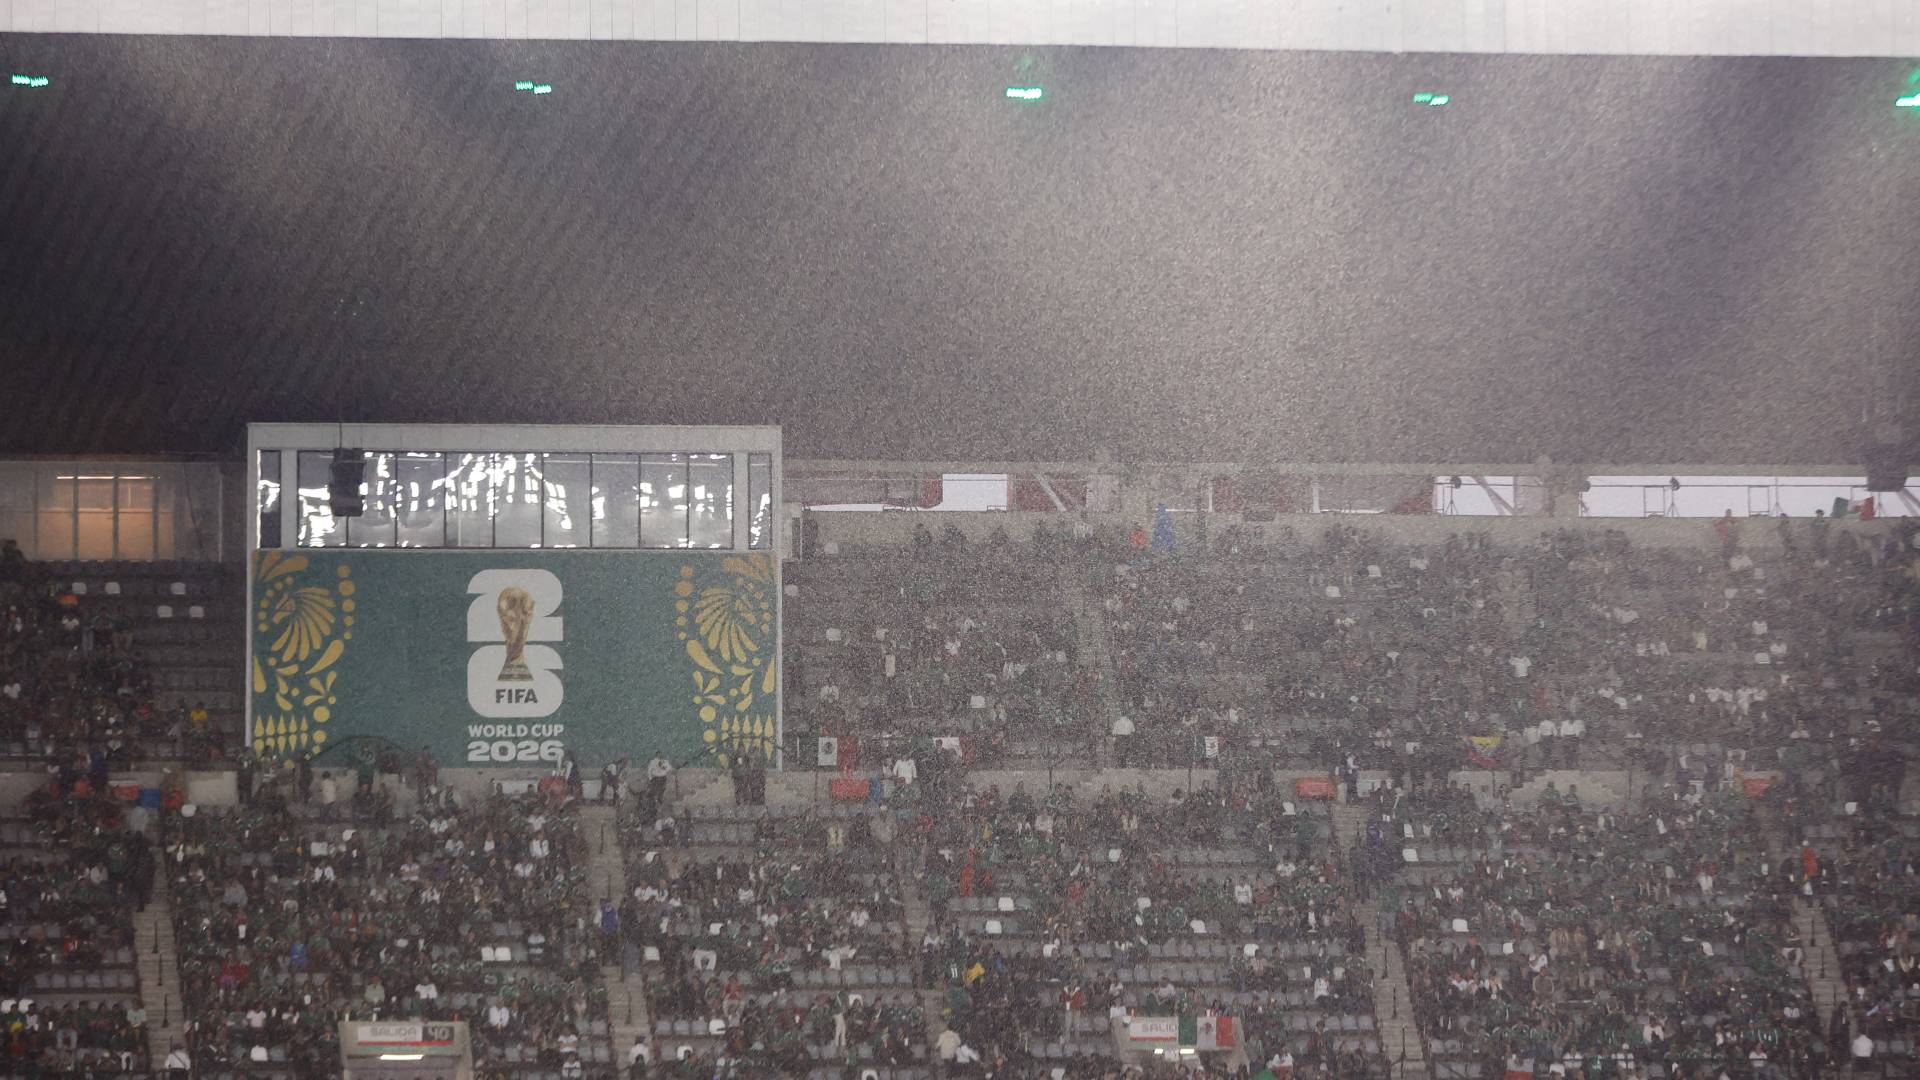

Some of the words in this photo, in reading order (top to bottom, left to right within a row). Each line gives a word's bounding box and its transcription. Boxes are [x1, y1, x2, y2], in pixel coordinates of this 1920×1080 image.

[495, 688, 538, 704] FIFA
[468, 724, 528, 738] WORLD
[531, 724, 564, 738] CUP
[467, 740, 564, 762] 2026
[427, 1026, 450, 1041] 40
[1141, 1023, 1178, 1033] SALID
